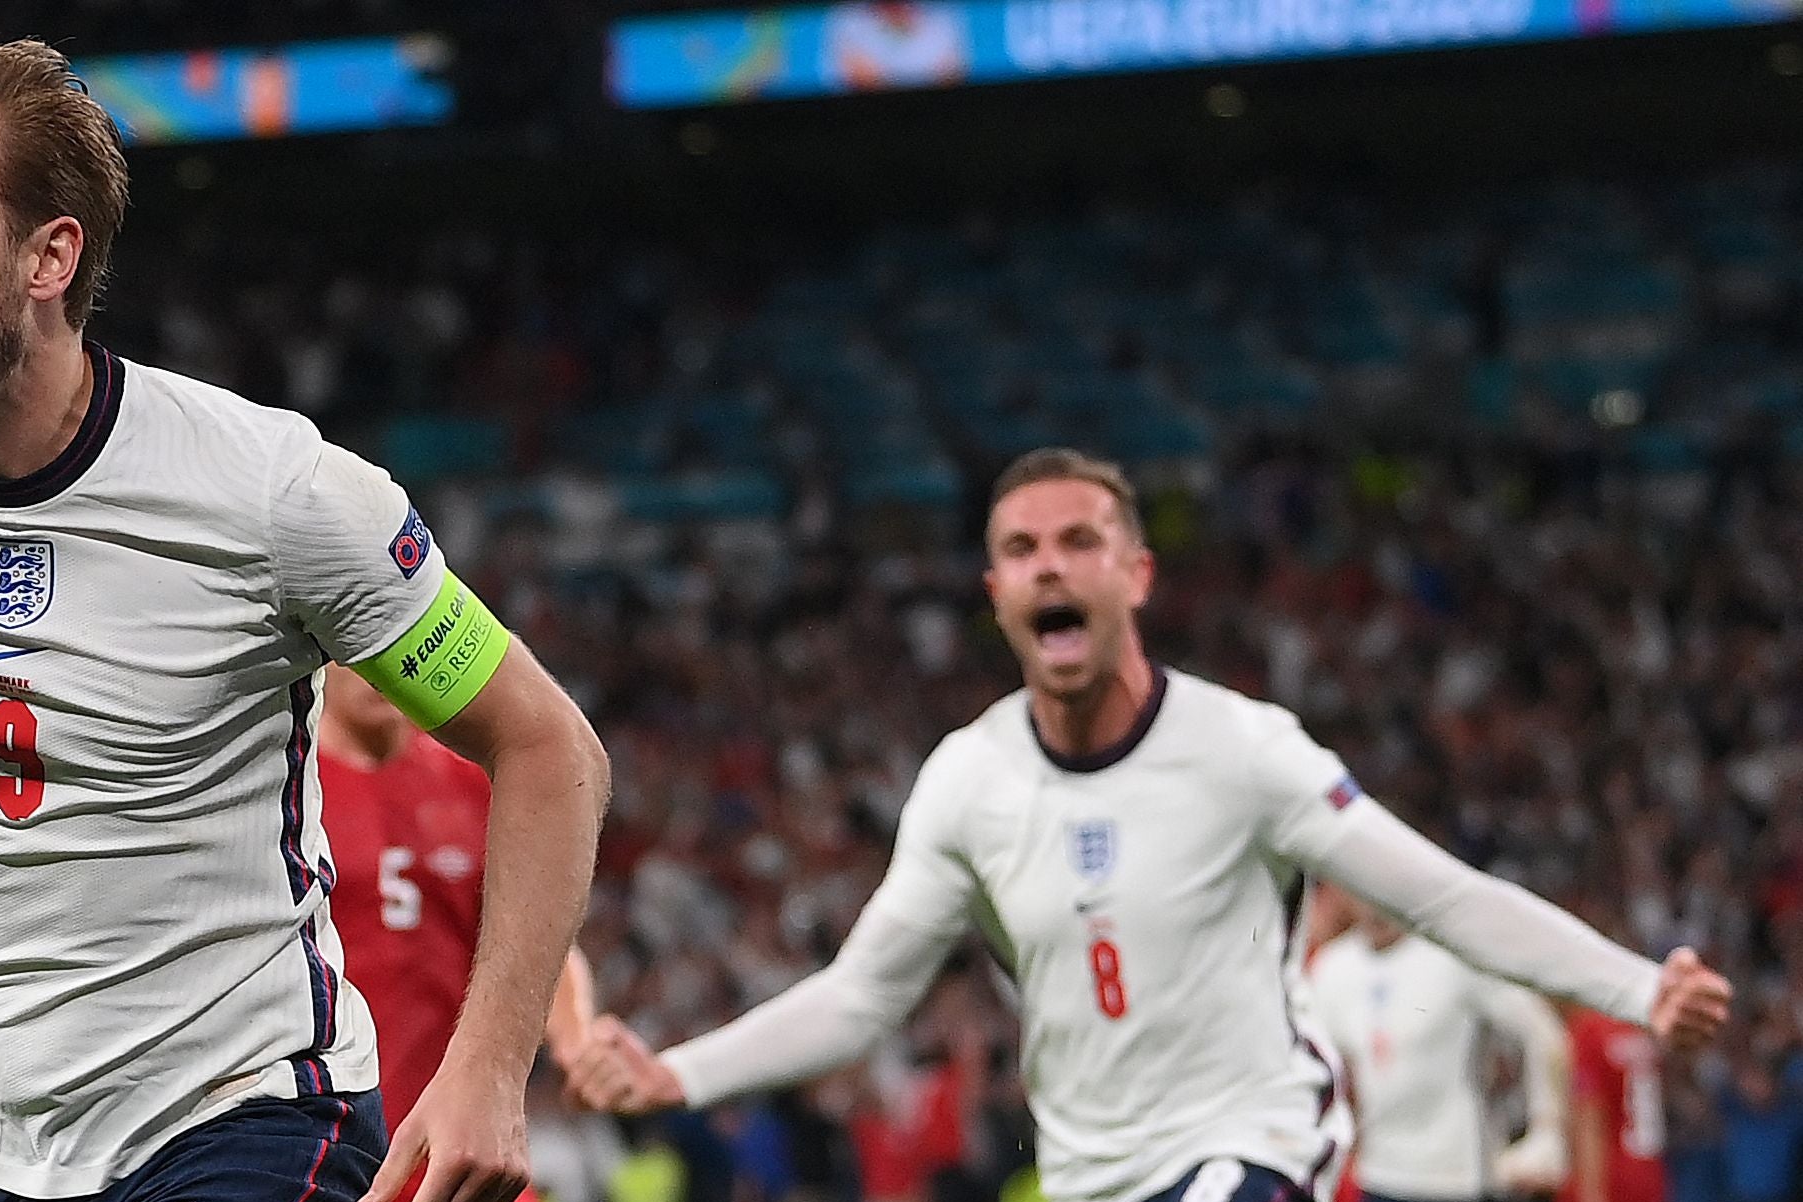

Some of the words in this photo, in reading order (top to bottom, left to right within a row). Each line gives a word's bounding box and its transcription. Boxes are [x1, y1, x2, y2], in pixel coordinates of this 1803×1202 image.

[399, 614, 456, 680] #EQUAL
[379, 845, 422, 931] 5
[1089, 937, 1127, 1020] 8
